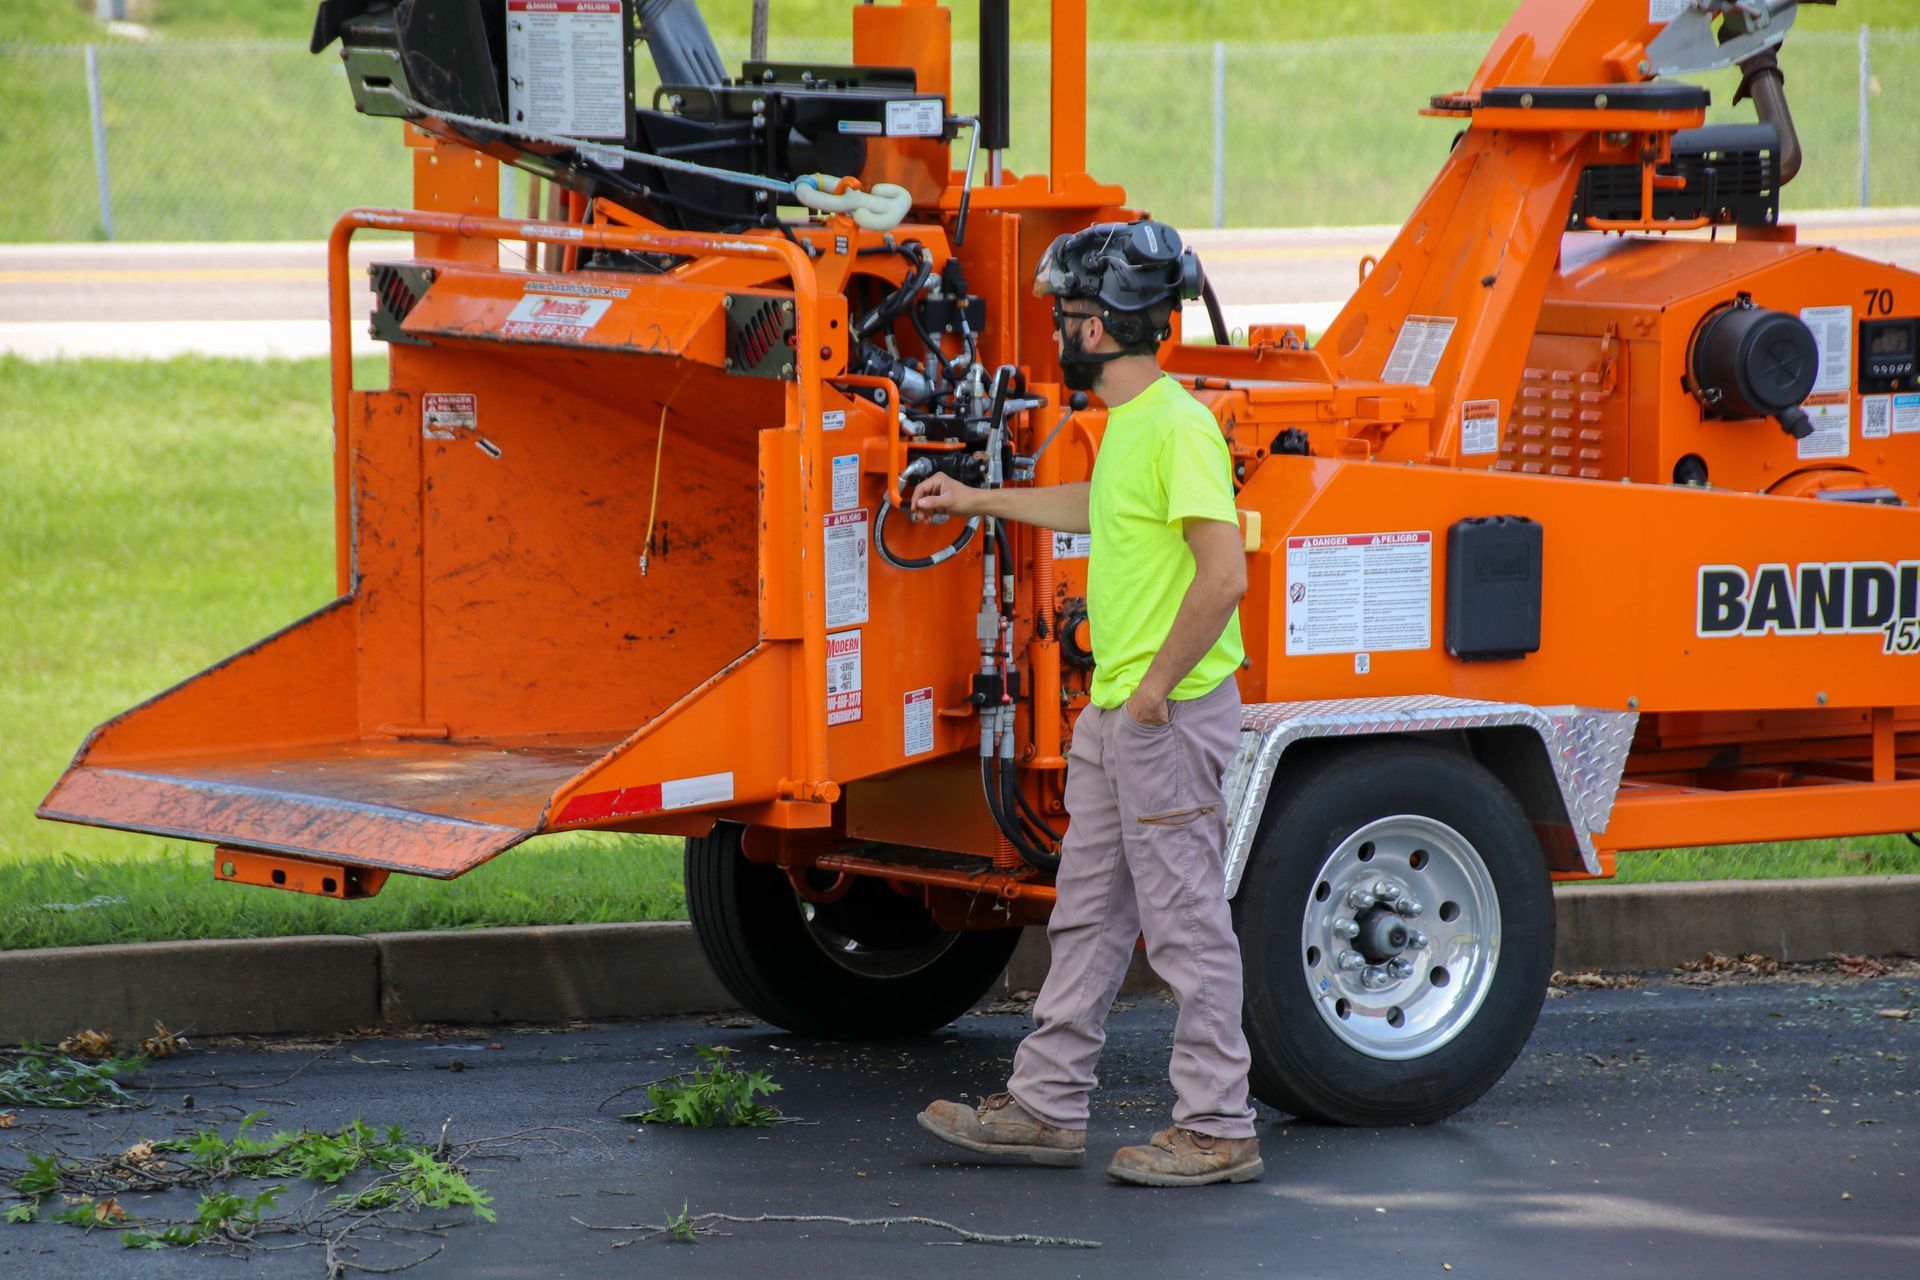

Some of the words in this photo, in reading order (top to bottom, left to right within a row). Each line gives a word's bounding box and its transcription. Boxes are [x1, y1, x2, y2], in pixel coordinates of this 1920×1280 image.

[1863, 288, 1894, 315] 70
[840, 512, 862, 523] PELIGRO
[1312, 536, 1348, 546] DANGER
[1381, 533, 1418, 543] PELIGRO
[826, 638, 859, 657] MODERN
